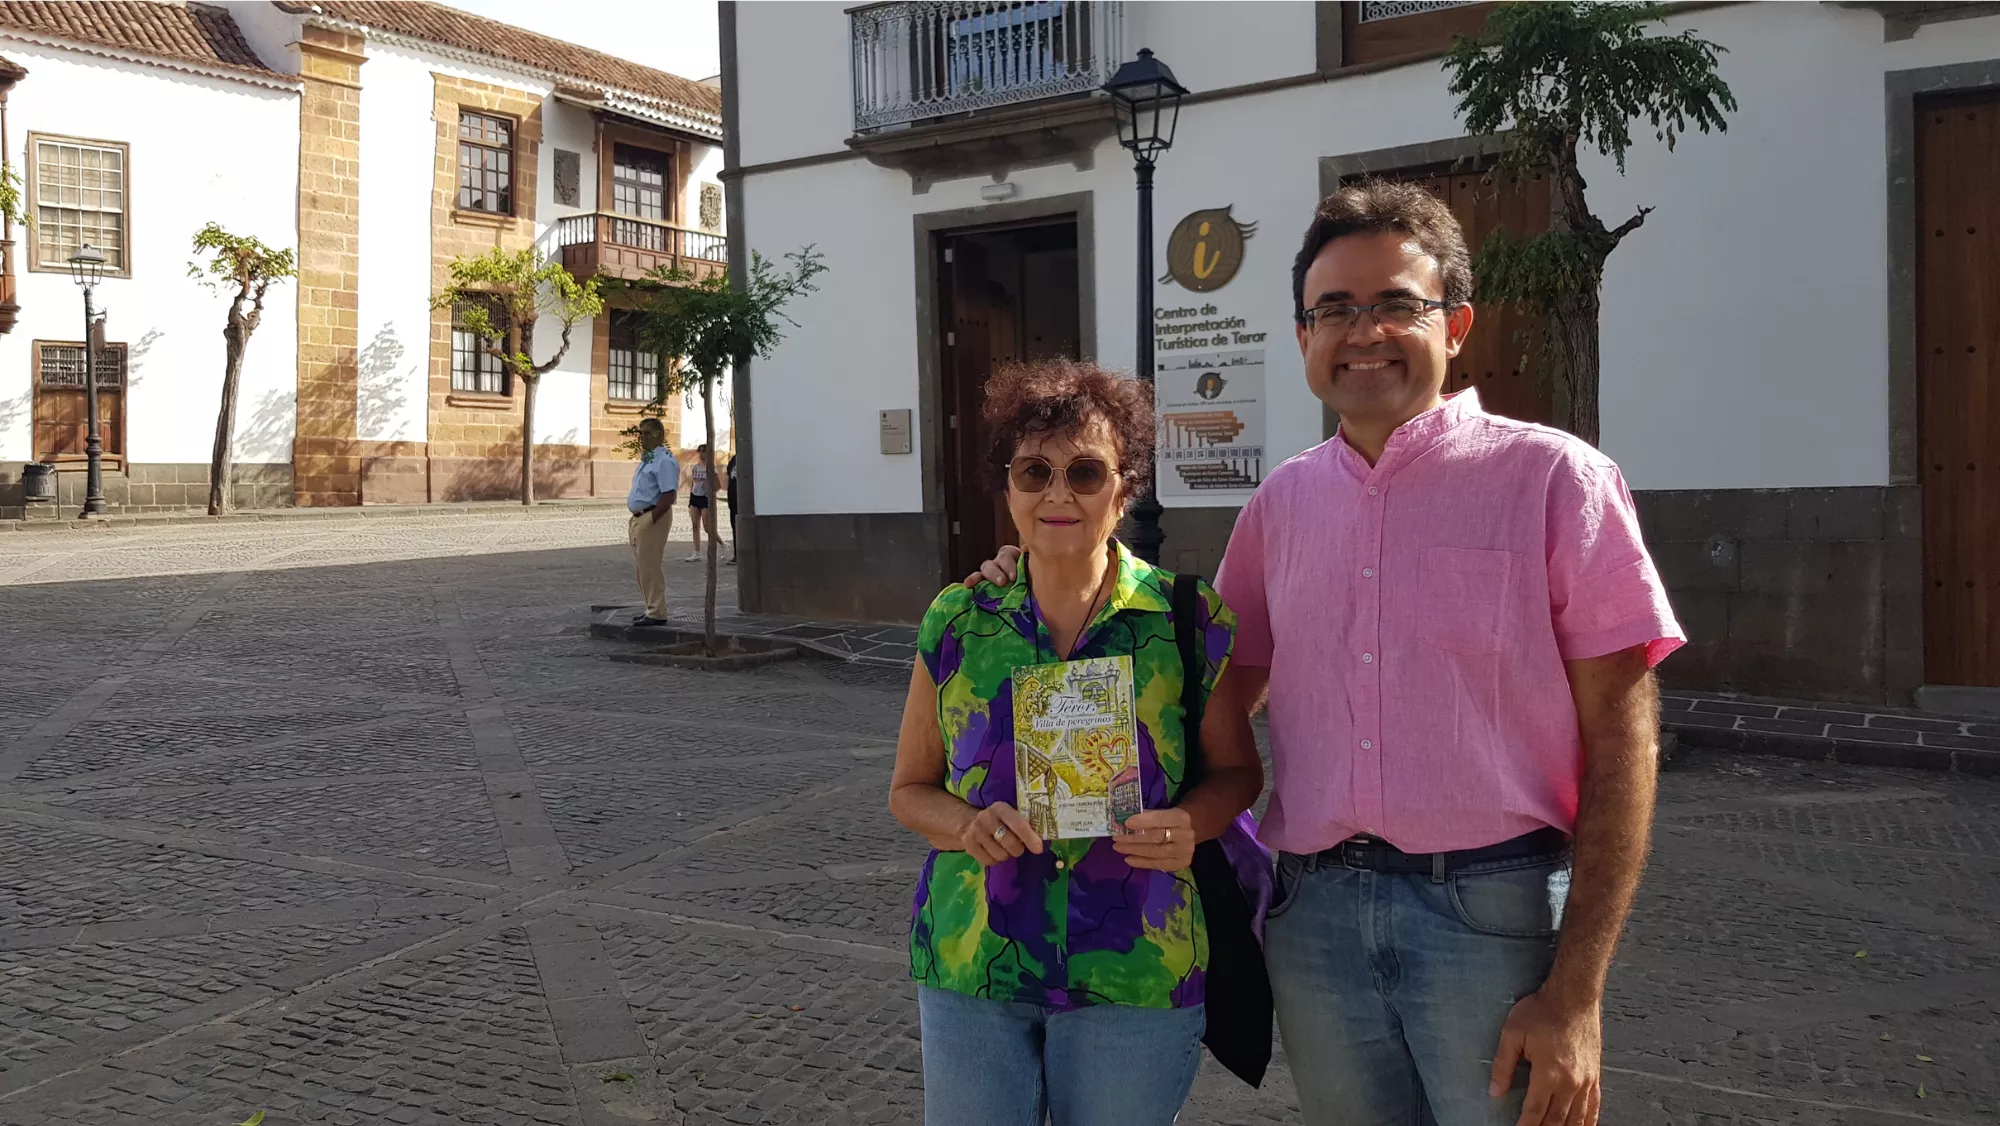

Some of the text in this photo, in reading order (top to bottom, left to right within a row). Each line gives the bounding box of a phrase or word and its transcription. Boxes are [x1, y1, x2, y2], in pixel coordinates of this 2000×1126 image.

[1154, 303, 1217, 320] Centro de
[1155, 316, 1246, 336] Interpretación
[1155, 331, 1267, 351] Turística de Teror
[1049, 696, 1095, 714] Teror,
[1035, 716, 1112, 728] Villa de peregrinos
